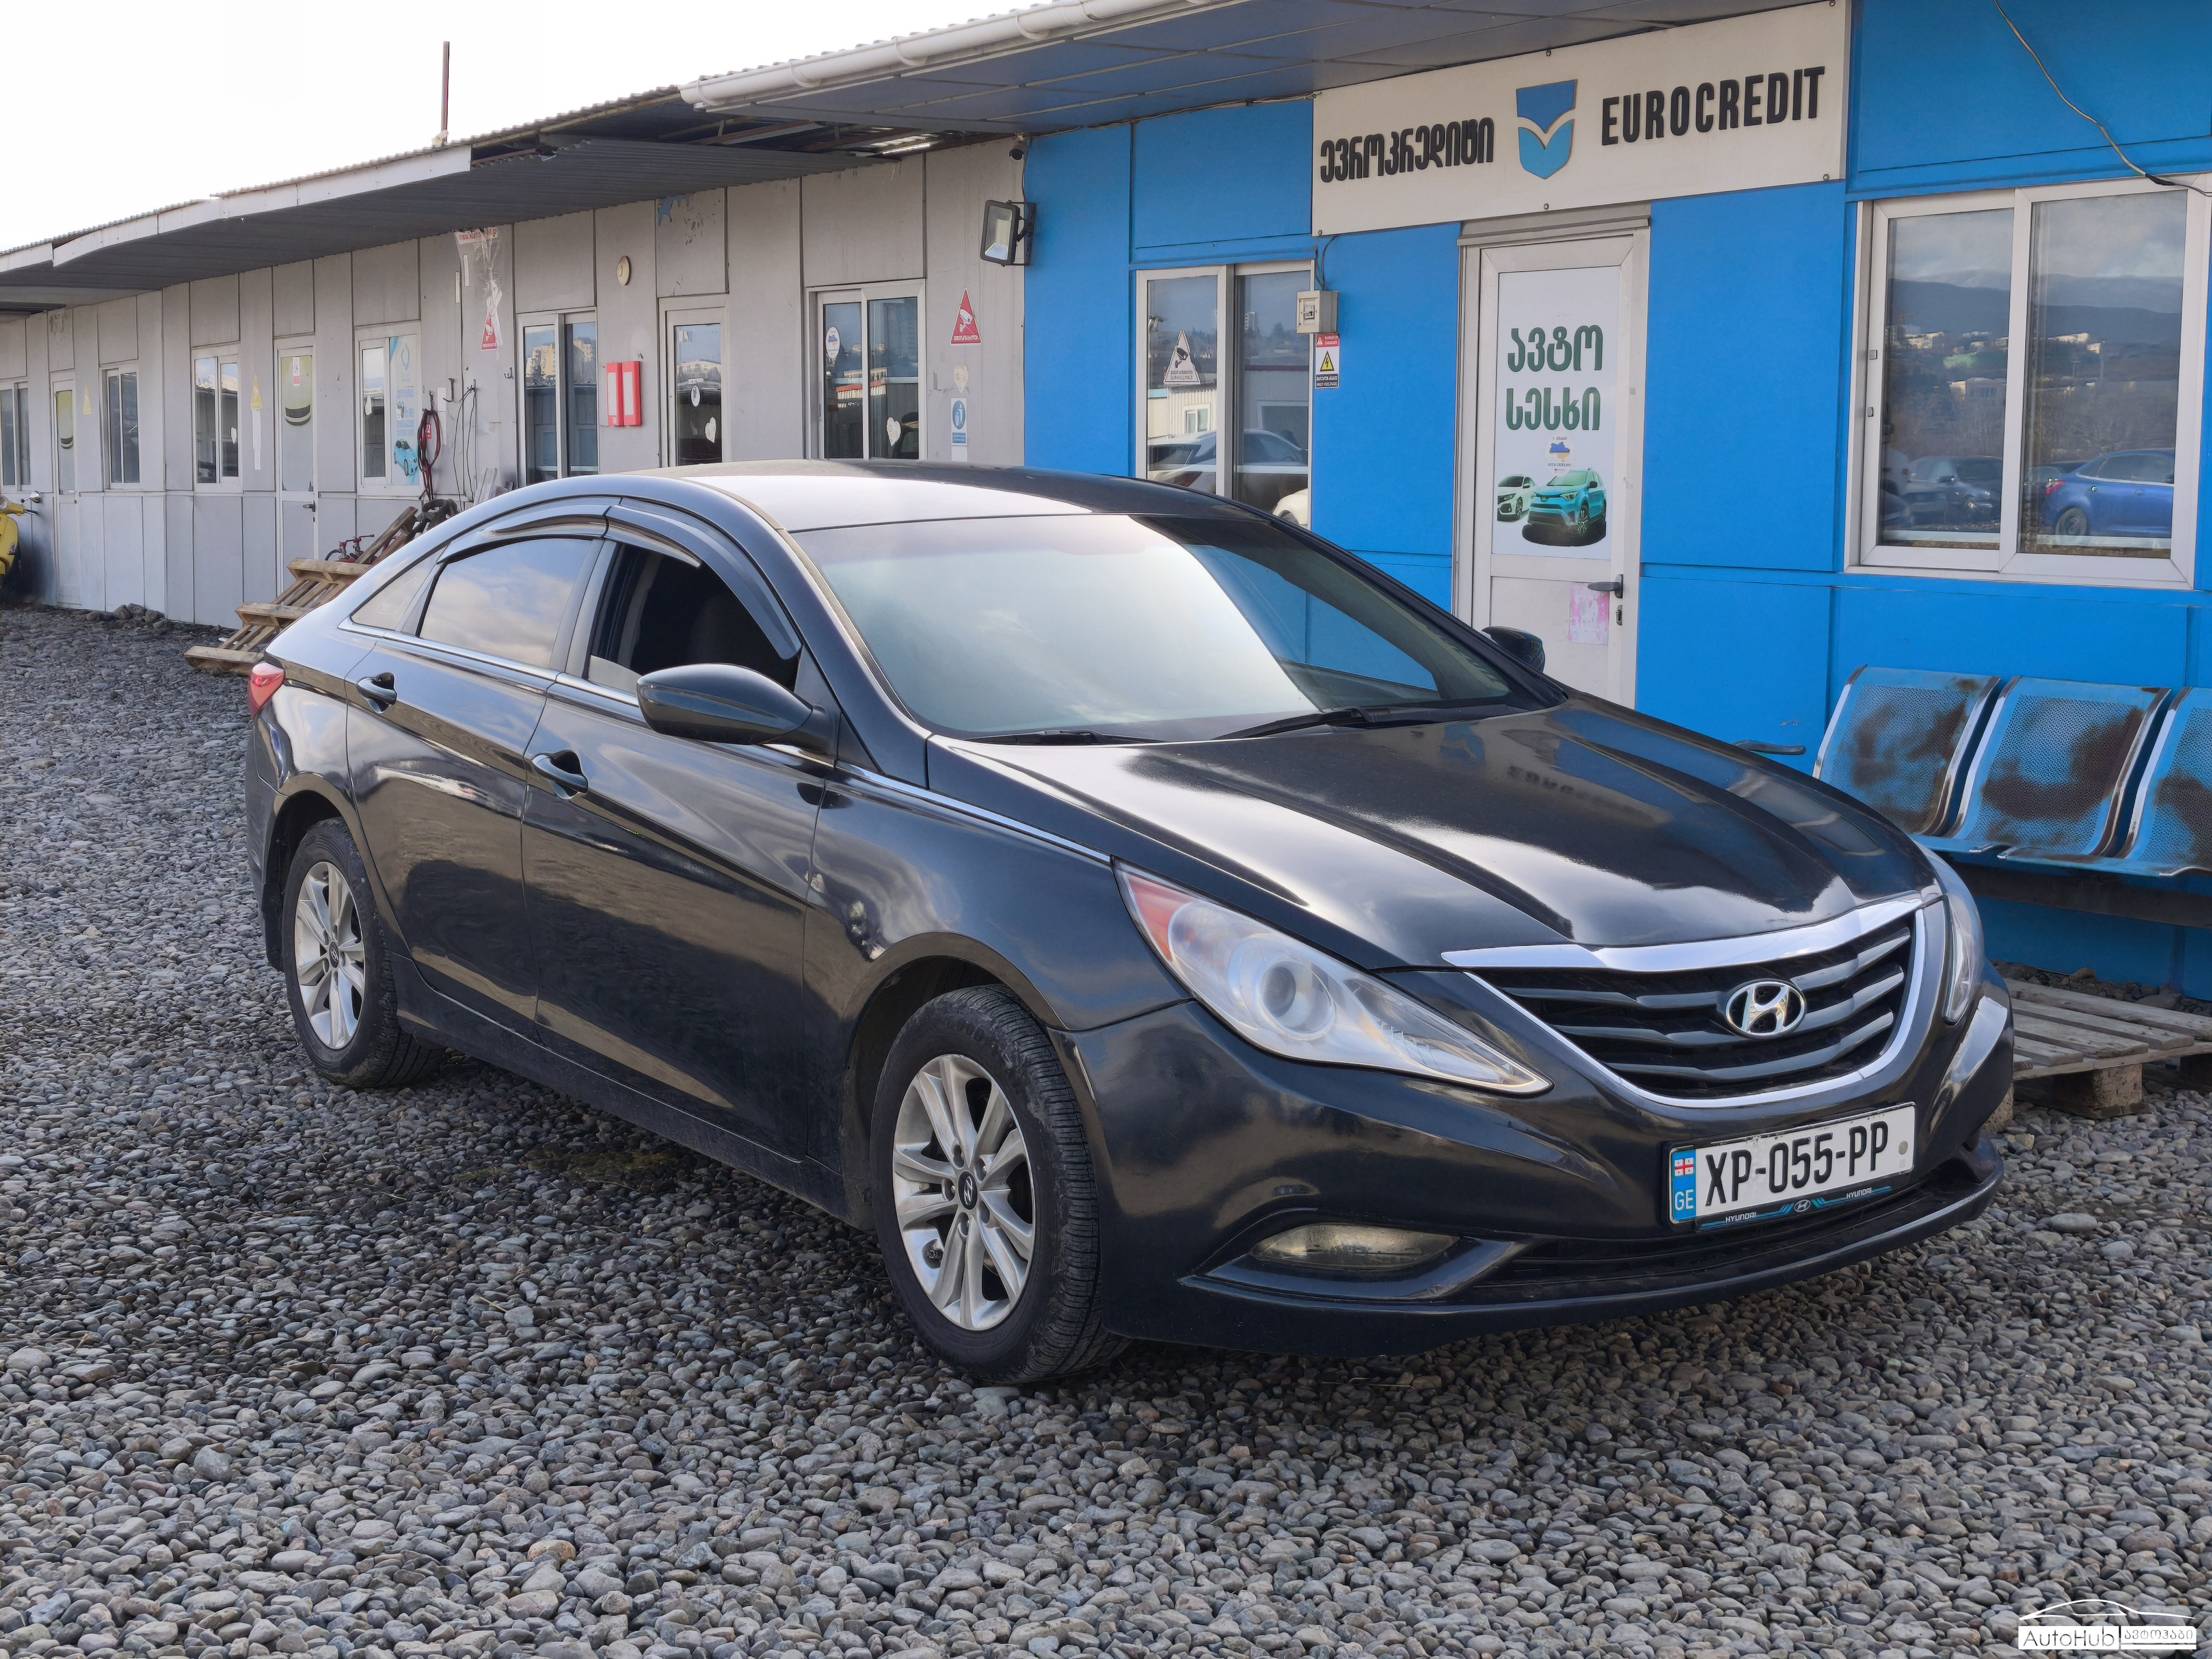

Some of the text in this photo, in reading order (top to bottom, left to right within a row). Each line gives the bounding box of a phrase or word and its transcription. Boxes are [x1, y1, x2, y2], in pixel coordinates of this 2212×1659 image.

[1602, 66, 1826, 146] EUROCREDIT
[1319, 117, 1494, 183] ევროკრედიტი
[1507, 324, 1604, 373] ავტო
[1506, 387, 1601, 431] სესხი
[1705, 1121, 1889, 1206] XP-055-PP
[1675, 1189, 1694, 1211] GE
[1846, 1187, 1872, 1199] HYUNDAI
[1725, 1211, 1757, 1223] HYUNDAI
